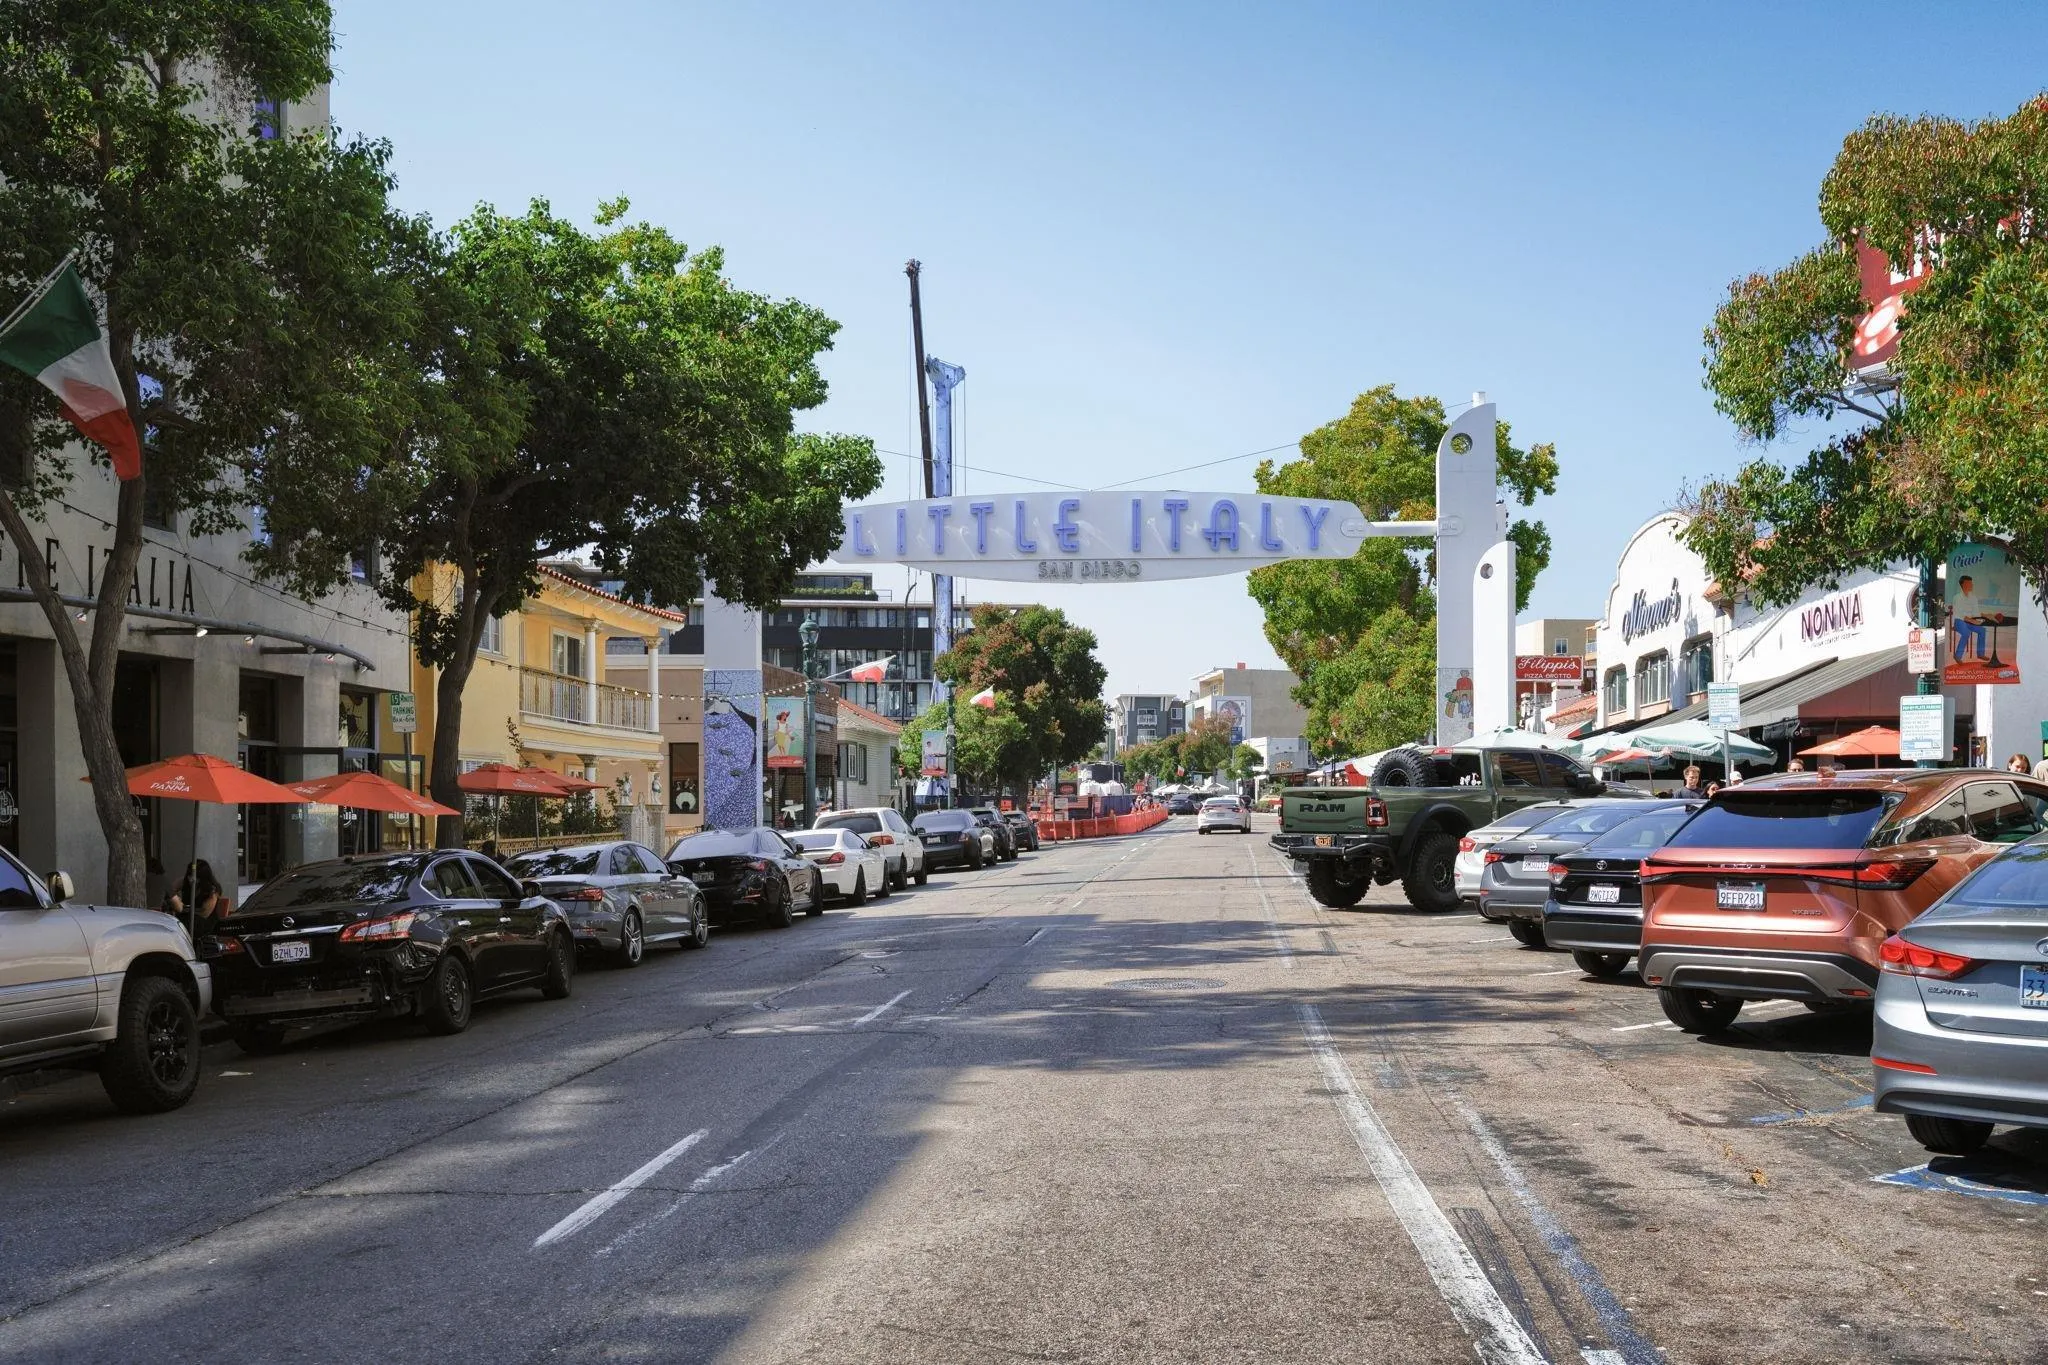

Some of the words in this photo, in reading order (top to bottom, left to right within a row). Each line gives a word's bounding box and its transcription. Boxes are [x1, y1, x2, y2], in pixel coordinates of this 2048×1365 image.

[853, 499, 1080, 555] LITTLE
[1132, 498, 1330, 552] ITALY
[1953, 550, 1985, 569] Ciao!
[1038, 561, 1073, 579] SAN
[1080, 561, 1142, 579] DIEGO
[1801, 592, 1863, 642] NONNA
[1910, 632, 1920, 642] NO
[1910, 644, 1932, 652] PARKING
[392, 694, 400, 705] 15
[393, 706, 415, 714] PARKING
[150, 783, 190, 792] PANNA
[1300, 803, 1346, 812] RAM
[273, 946, 310, 960] 8ZHL791
